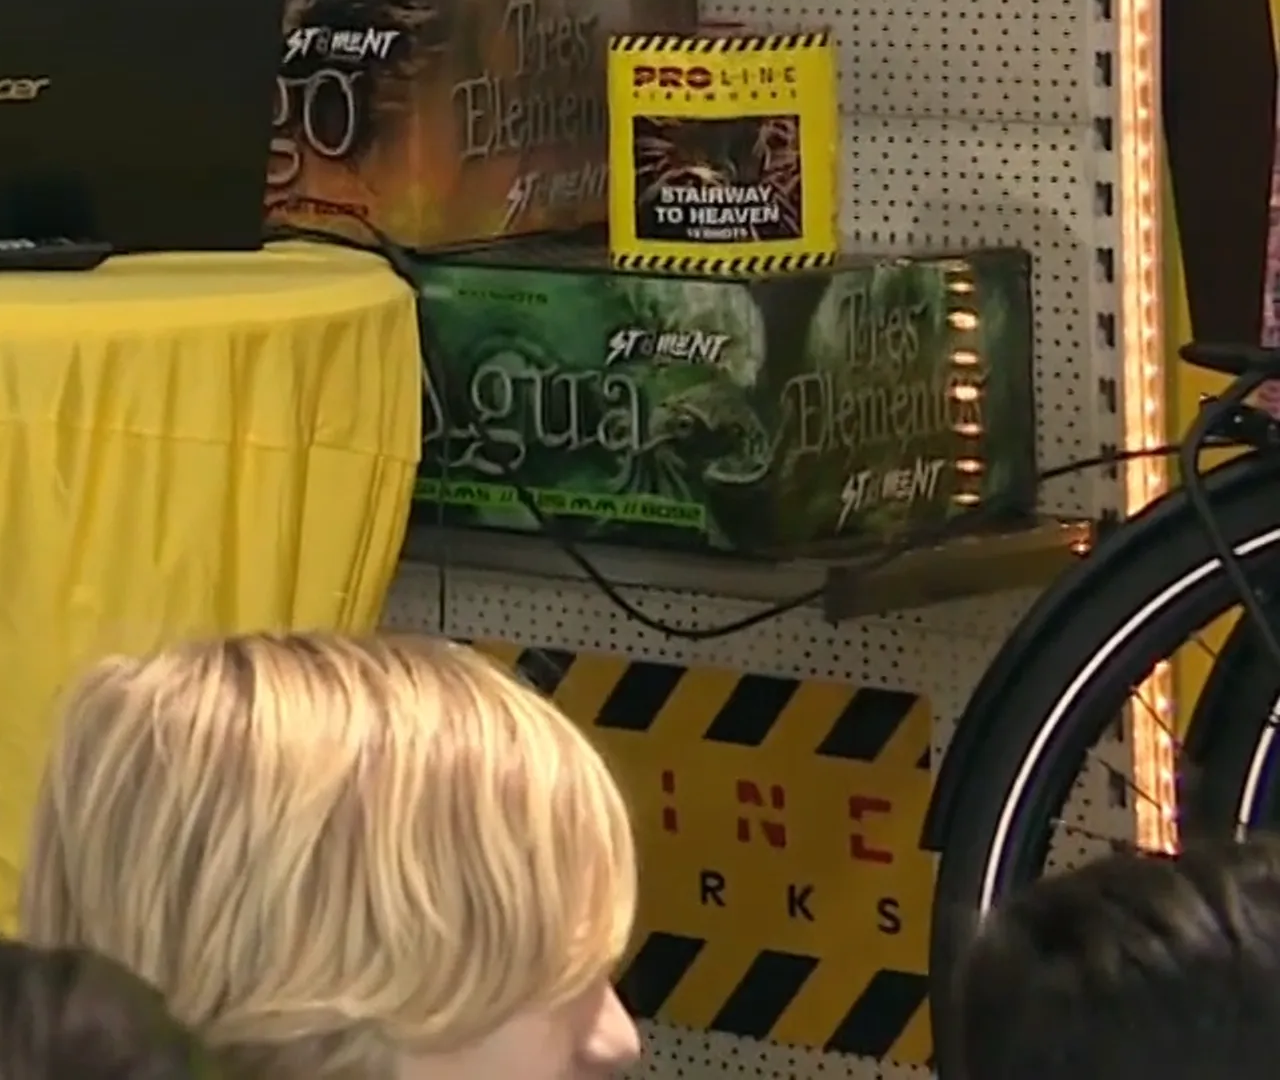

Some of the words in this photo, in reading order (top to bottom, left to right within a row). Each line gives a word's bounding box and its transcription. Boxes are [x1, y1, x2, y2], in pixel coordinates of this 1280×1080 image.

[633, 66, 712, 88] PRO
[660, 186, 775, 204] STAIRWAY
[654, 207, 683, 224] TO
[690, 205, 780, 225] HEAVEN
